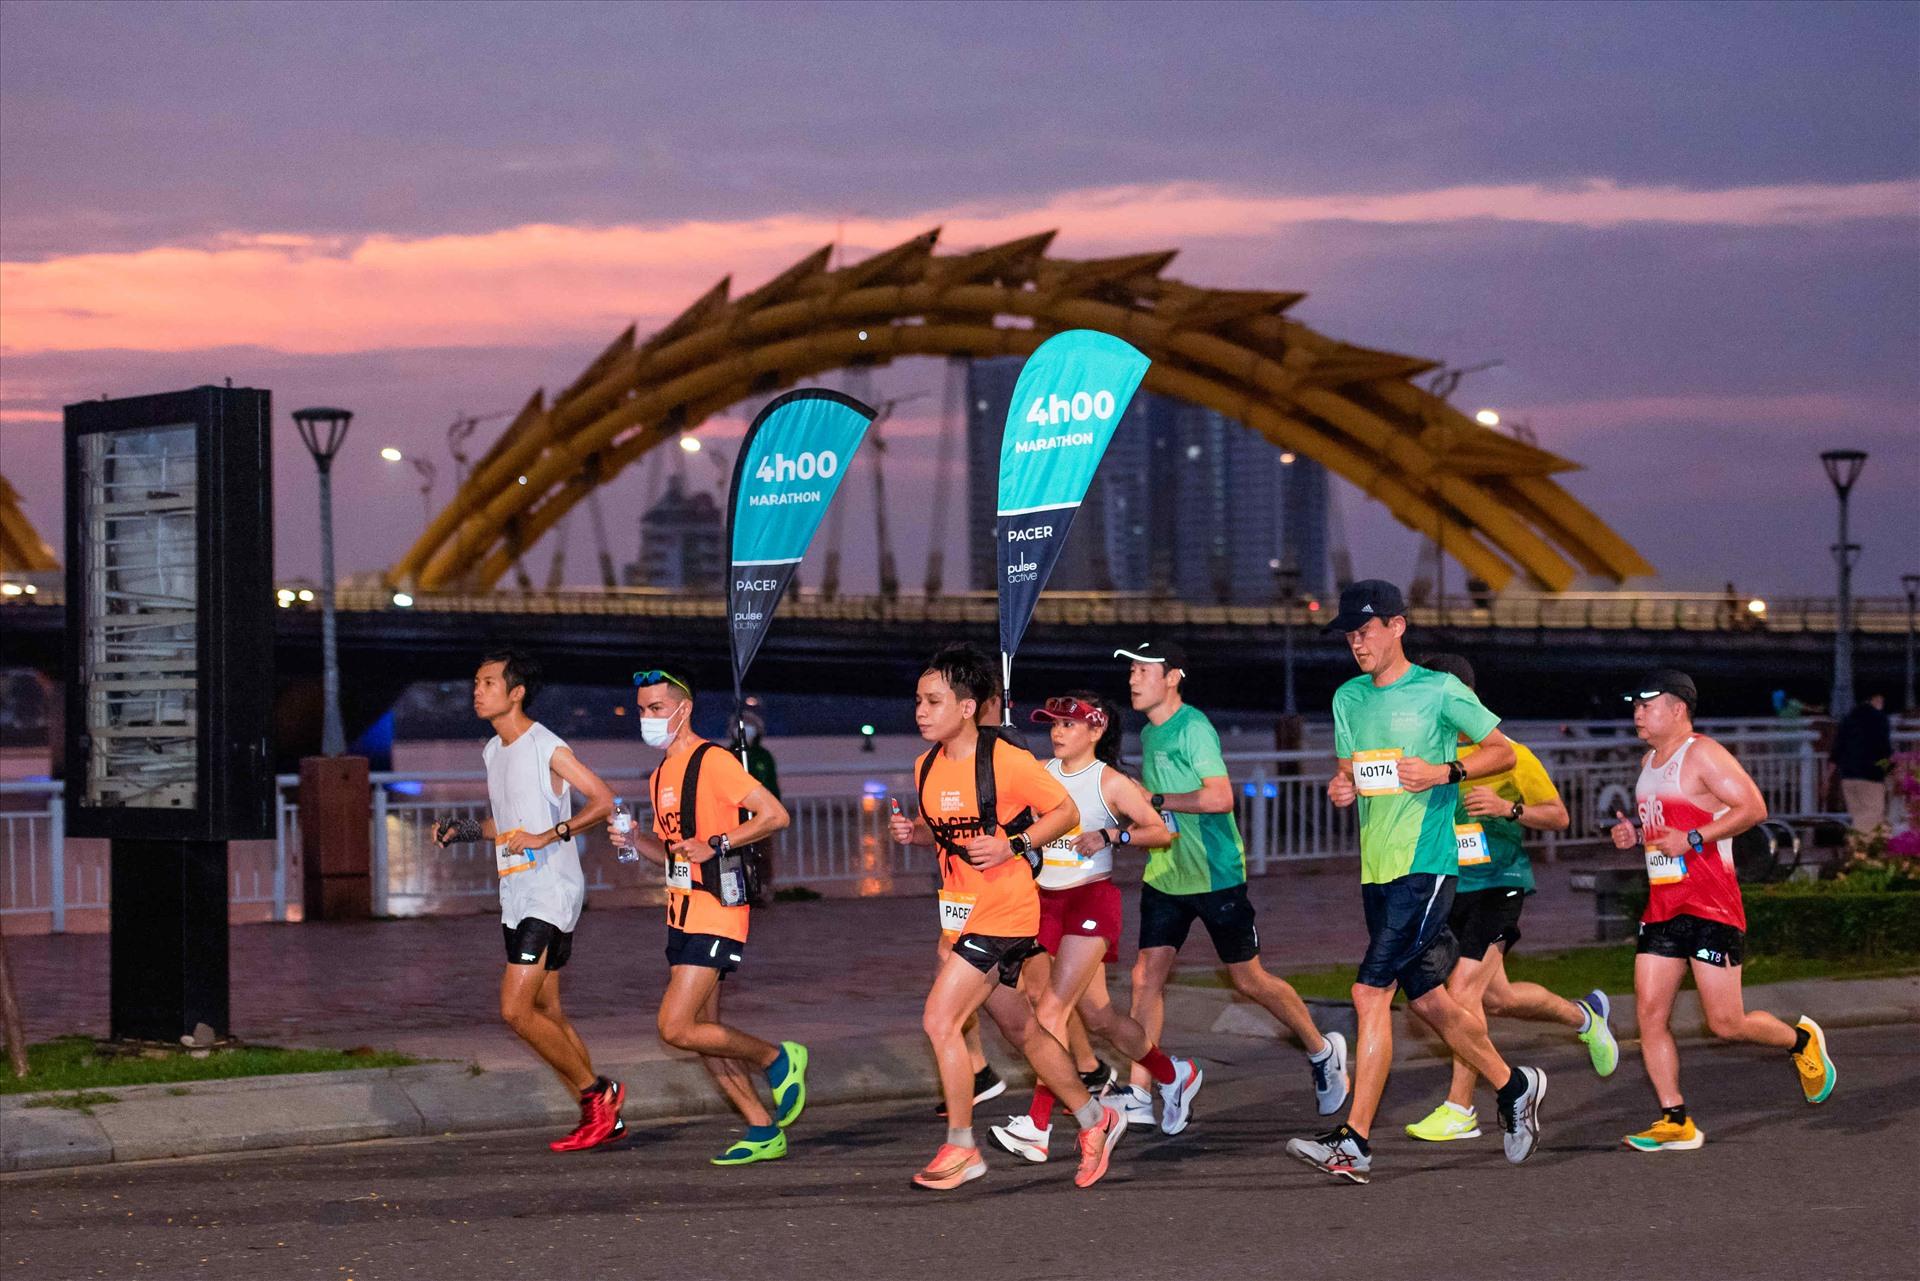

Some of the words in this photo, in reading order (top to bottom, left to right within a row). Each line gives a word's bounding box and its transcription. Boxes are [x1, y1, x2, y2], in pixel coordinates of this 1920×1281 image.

[1026, 389, 1115, 427] 4h00
[1015, 432, 1094, 453] MARATHON
[755, 450, 838, 483] 4h00
[749, 490, 821, 506] MARATHON
[1007, 525, 1053, 542] PACER
[1007, 551, 1038, 575] pulse
[736, 579, 778, 592] PACER
[1007, 571, 1038, 584] active
[734, 600, 763, 621] pulse
[1360, 764, 1393, 778] 40174
[1456, 837, 1477, 849] 085
[945, 905, 971, 920] PACE
